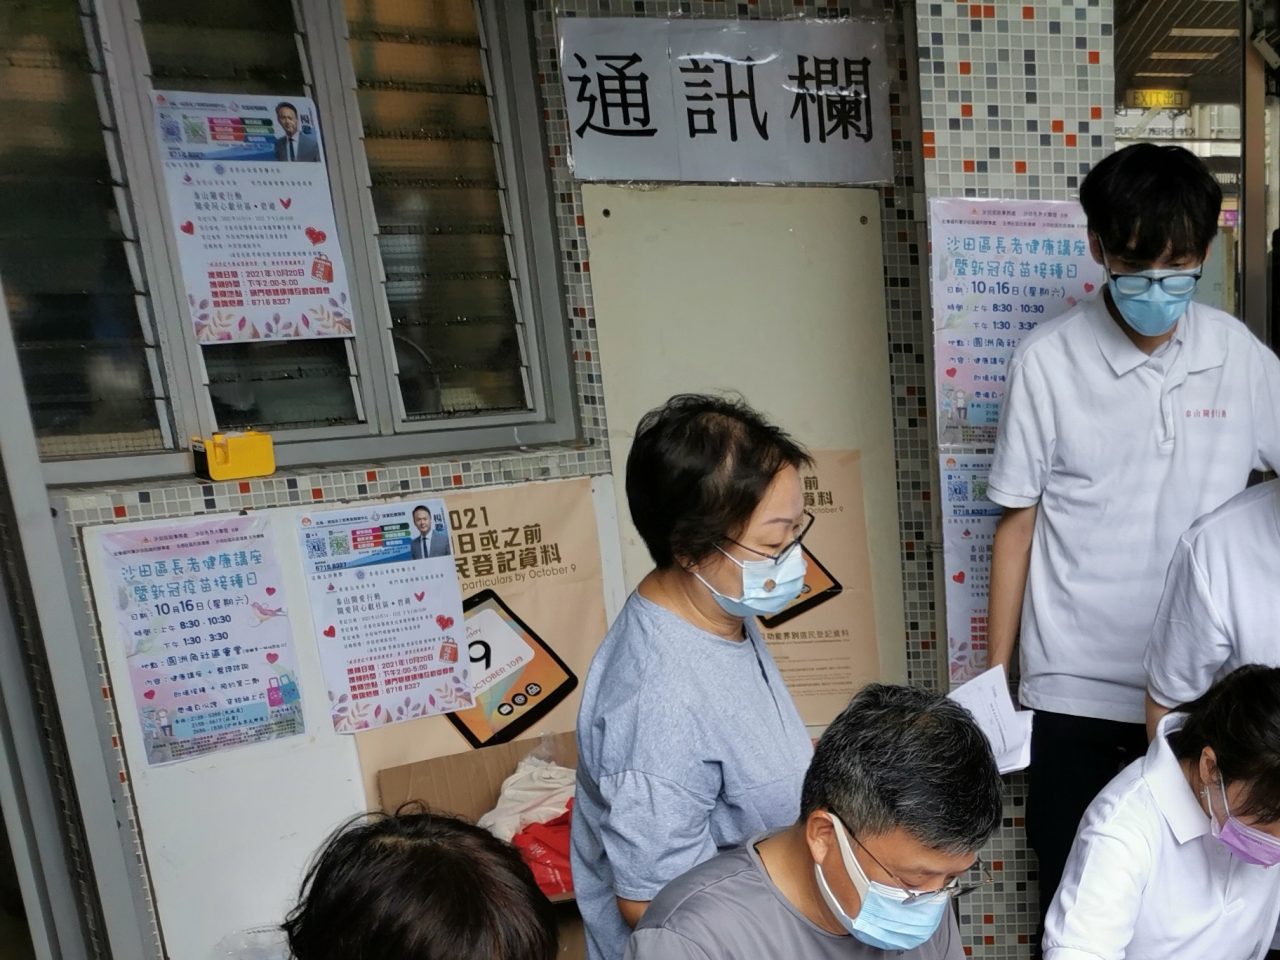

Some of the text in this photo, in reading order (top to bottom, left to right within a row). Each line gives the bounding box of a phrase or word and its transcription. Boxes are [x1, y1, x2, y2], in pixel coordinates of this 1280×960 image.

[567, 52, 872, 144] 通訊欄
[1133, 92, 1183, 106] EXIT 出口
[946, 235, 1086, 257] 沙田區長者健康講座
[954, 259, 1078, 279] 暨新冠疫苗接種日
[992, 303, 1013, 313] 8:30
[1020, 304, 1044, 314] 10:30
[992, 320, 1011, 330] 1:30
[807, 506, 837, 515] October
[451, 523, 542, 554] 日或之前
[121, 549, 263, 580] 沙田區長者健康講座
[134, 572, 259, 603] 暨新冠疫苗接種日
[462, 564, 577, 592] particulars by October 9
[180, 619, 200, 631] 8:30
[207, 614, 232, 626] 10:30
[183, 635, 201, 647] 1:30
[208, 631, 229, 642] 3:30
[468, 640, 491, 671] 9
